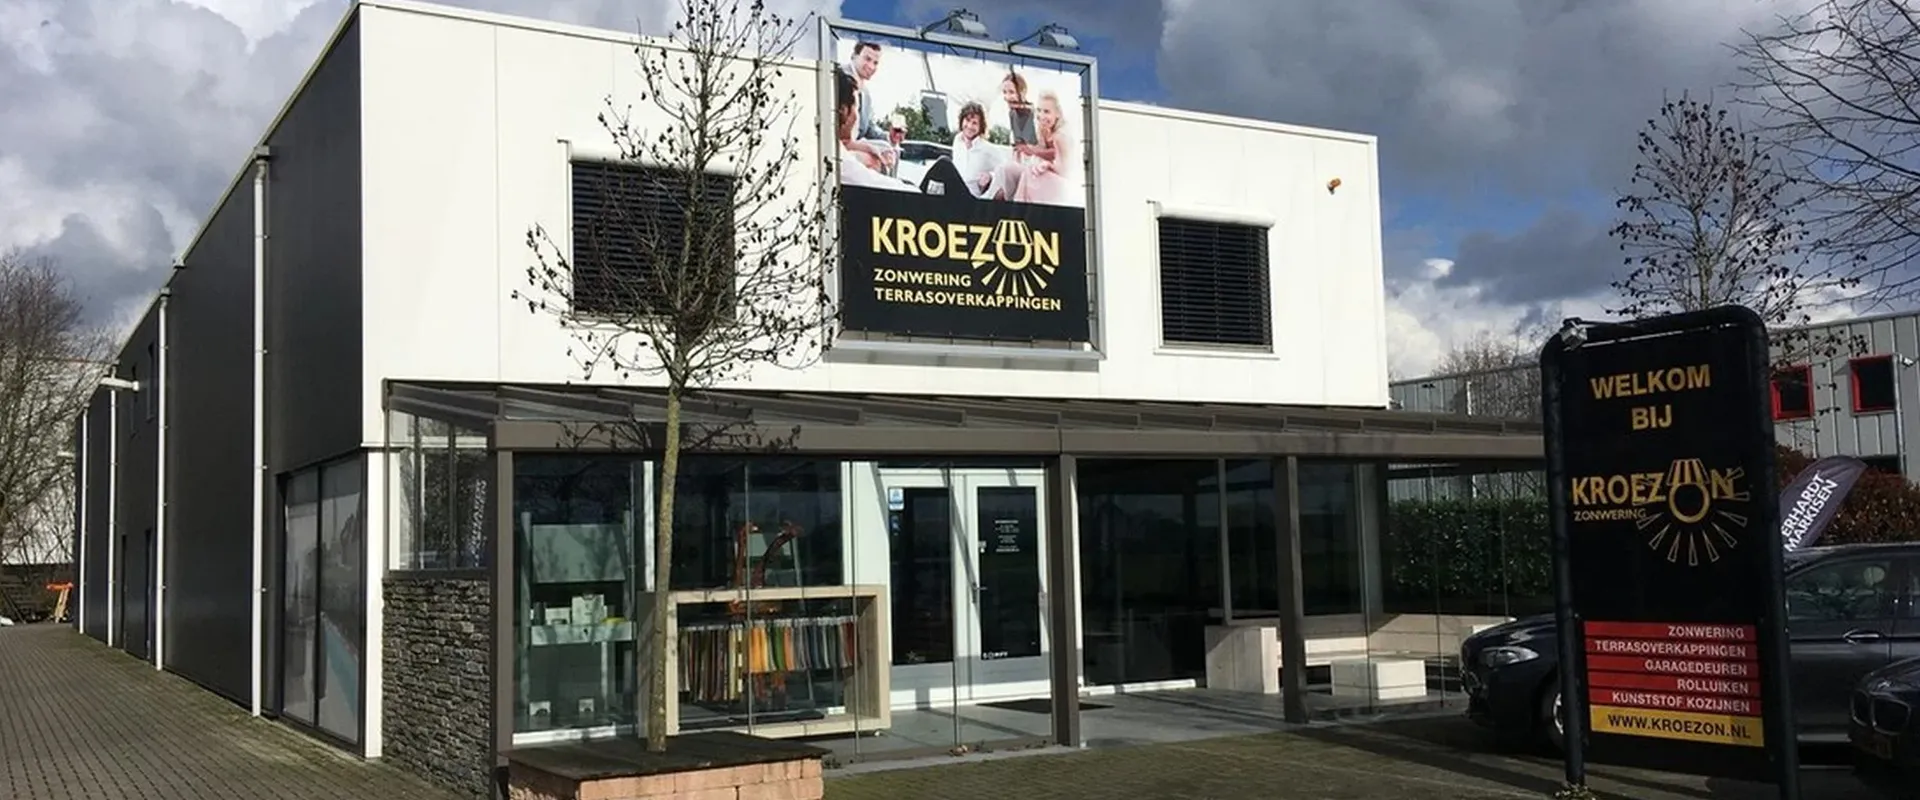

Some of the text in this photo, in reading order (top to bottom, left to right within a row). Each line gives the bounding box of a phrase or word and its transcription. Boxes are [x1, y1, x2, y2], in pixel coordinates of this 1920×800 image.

[871, 216, 1060, 270] KROEZON
[873, 268, 972, 287] ZONWERING
[874, 287, 1062, 311] TERRASOVERKAPPINGEN
[1590, 364, 1712, 400] WELKOM
[1631, 404, 1673, 431] BIJ
[1571, 462, 1736, 522] KROEZON
[1780, 470, 1825, 537] ERHARDT
[1573, 507, 1647, 522] ZONWERING
[1783, 479, 1838, 552] MARKISEN
[1668, 625, 1744, 639] ZONWERING
[1595, 640, 1746, 657] TERRASOVERKAPPINGEN
[1644, 659, 1748, 675] GARAGEDEUREN
[1677, 678, 1749, 694] ROLLUIKEN
[1612, 691, 1750, 713] KUNSTSTOF KOZIJNEN
[1607, 714, 1752, 739] WWW.KROEZON.NL
